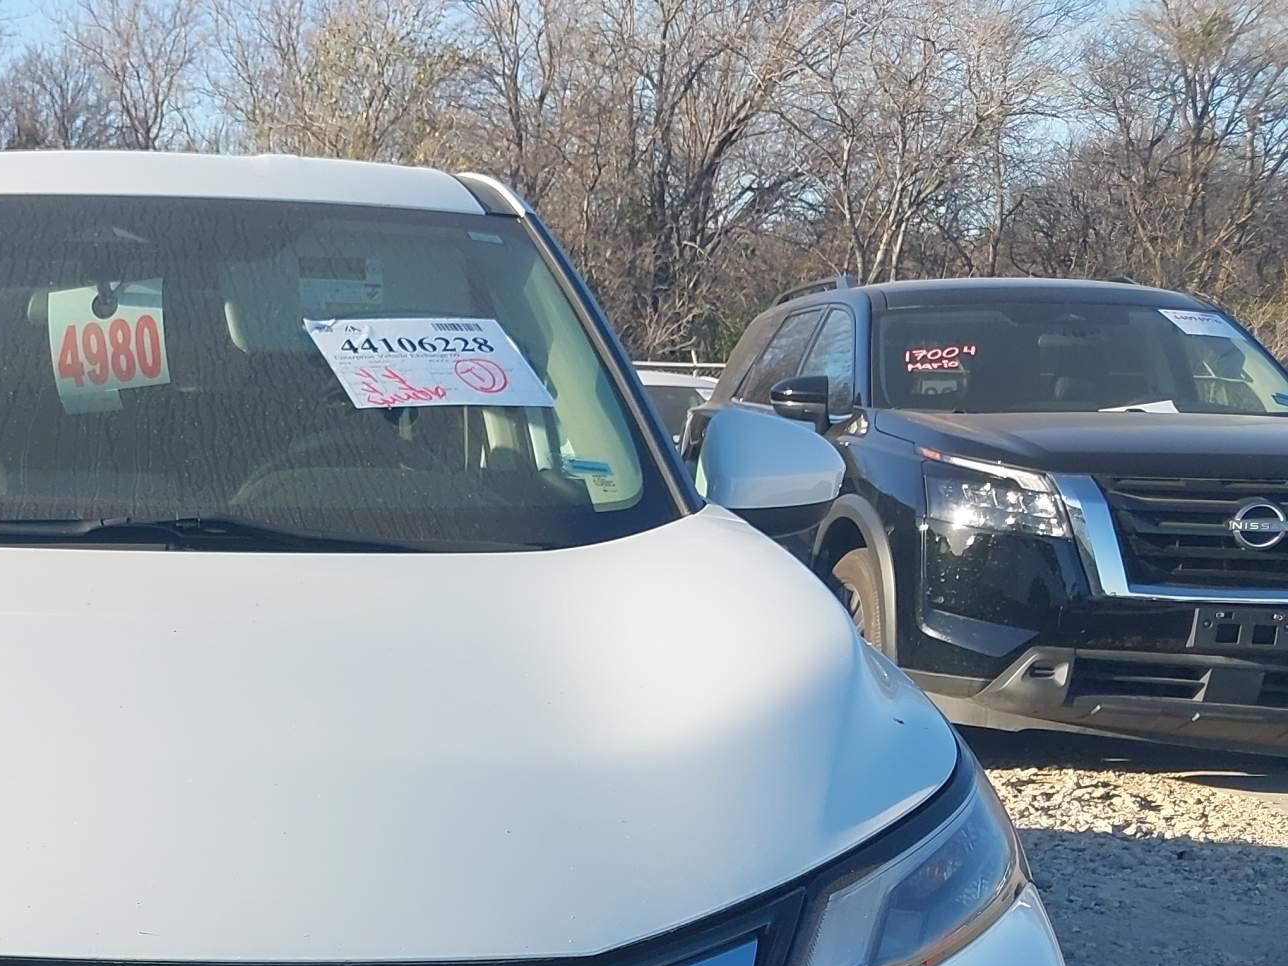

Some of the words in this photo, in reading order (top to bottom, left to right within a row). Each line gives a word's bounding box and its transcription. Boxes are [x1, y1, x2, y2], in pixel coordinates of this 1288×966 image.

[58, 315, 162, 388] 4980
[340, 336, 494, 354] 44106228
[905, 345, 976, 362] 17004
